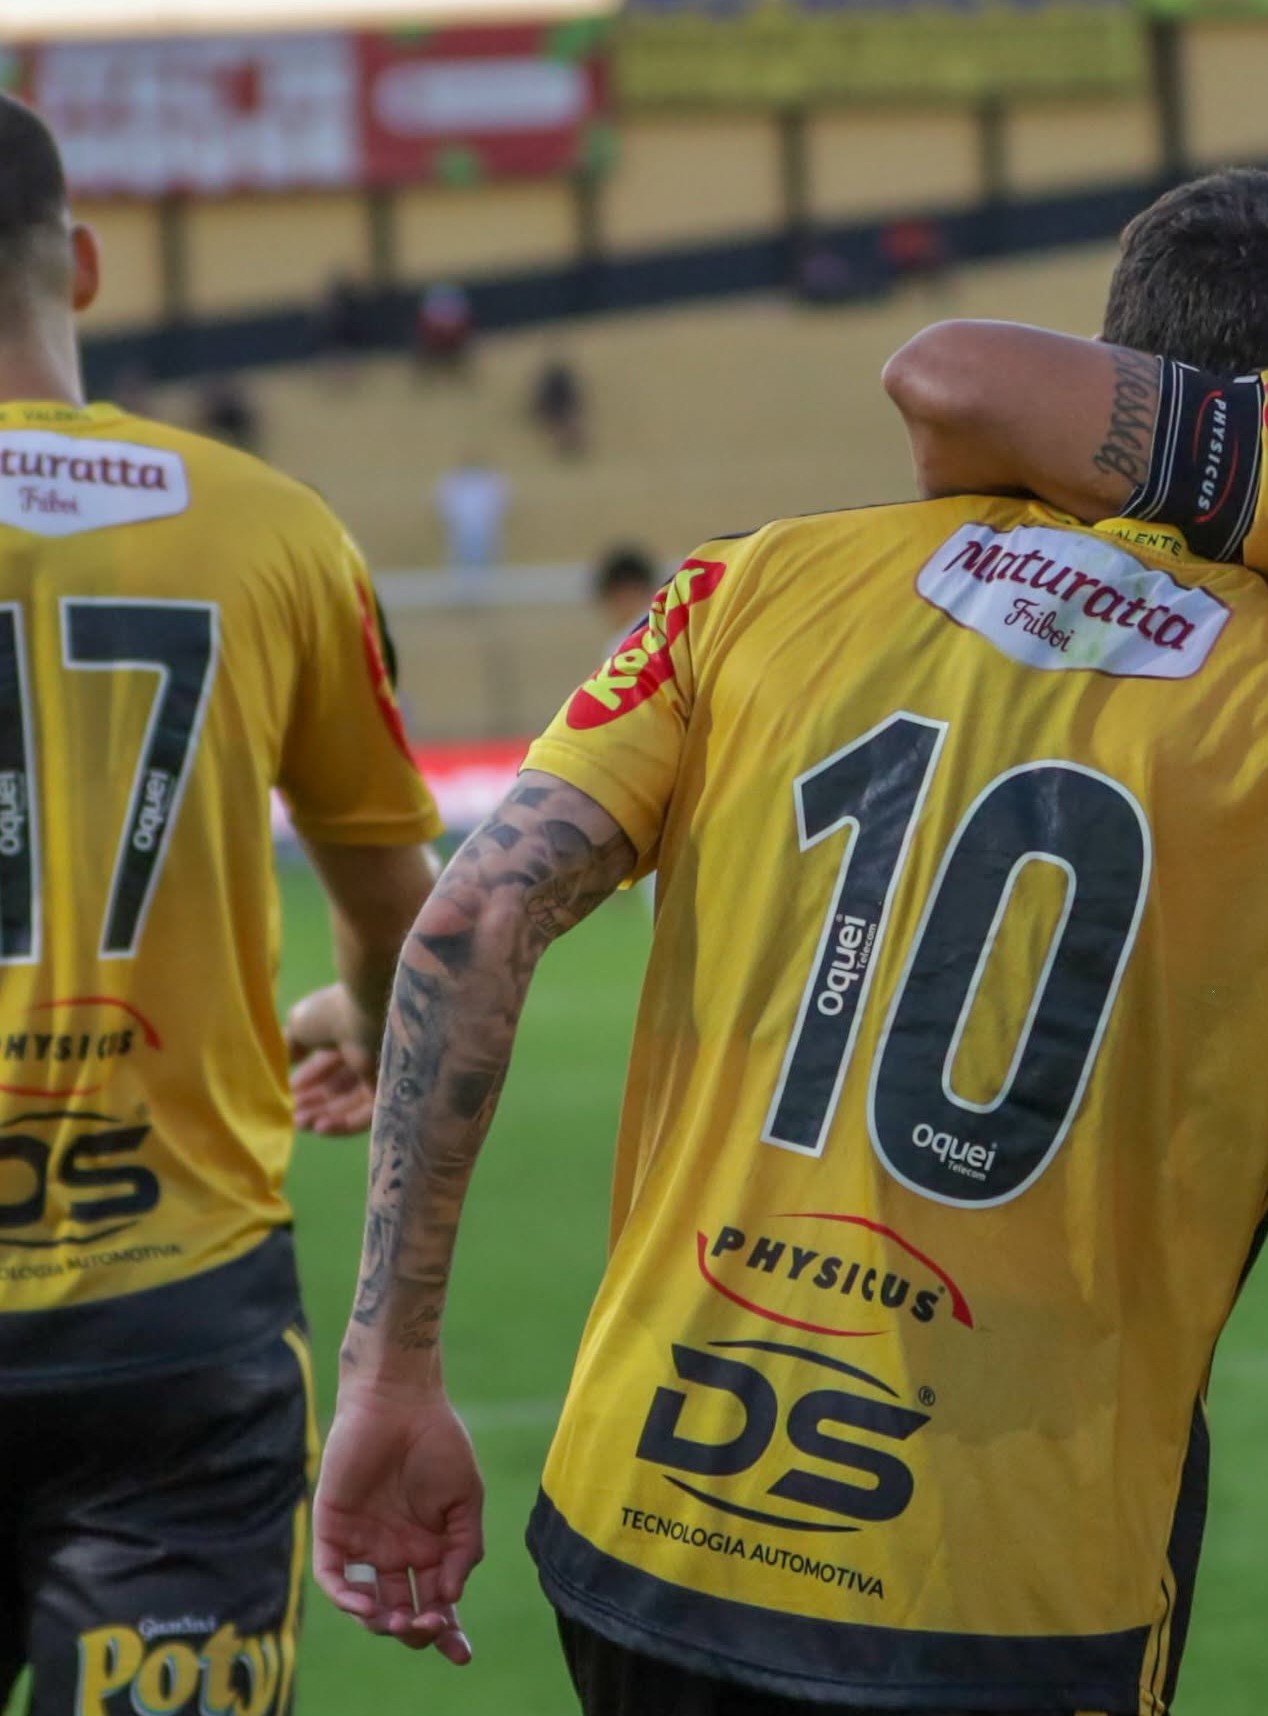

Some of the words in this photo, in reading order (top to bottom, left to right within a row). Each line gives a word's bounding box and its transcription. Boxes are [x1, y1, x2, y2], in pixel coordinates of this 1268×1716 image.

[0, 448, 168, 491] turatta
[1197, 397, 1228, 511] PHYSICUS
[1112, 528, 1182, 556] ALENTE
[942, 540, 1197, 651] Maturatta
[1004, 598, 1076, 653] Friboi
[760, 710, 1152, 1209] 10
[856, 923, 877, 970] Telecom
[947, 1157, 987, 1182] Telecom
[711, 1226, 940, 1323] PHYSICUS
[636, 1344, 931, 1522] DS
[621, 1506, 745, 1559] TECNOLOGIA
[750, 1542, 884, 1600] AUTOMOTIVA
